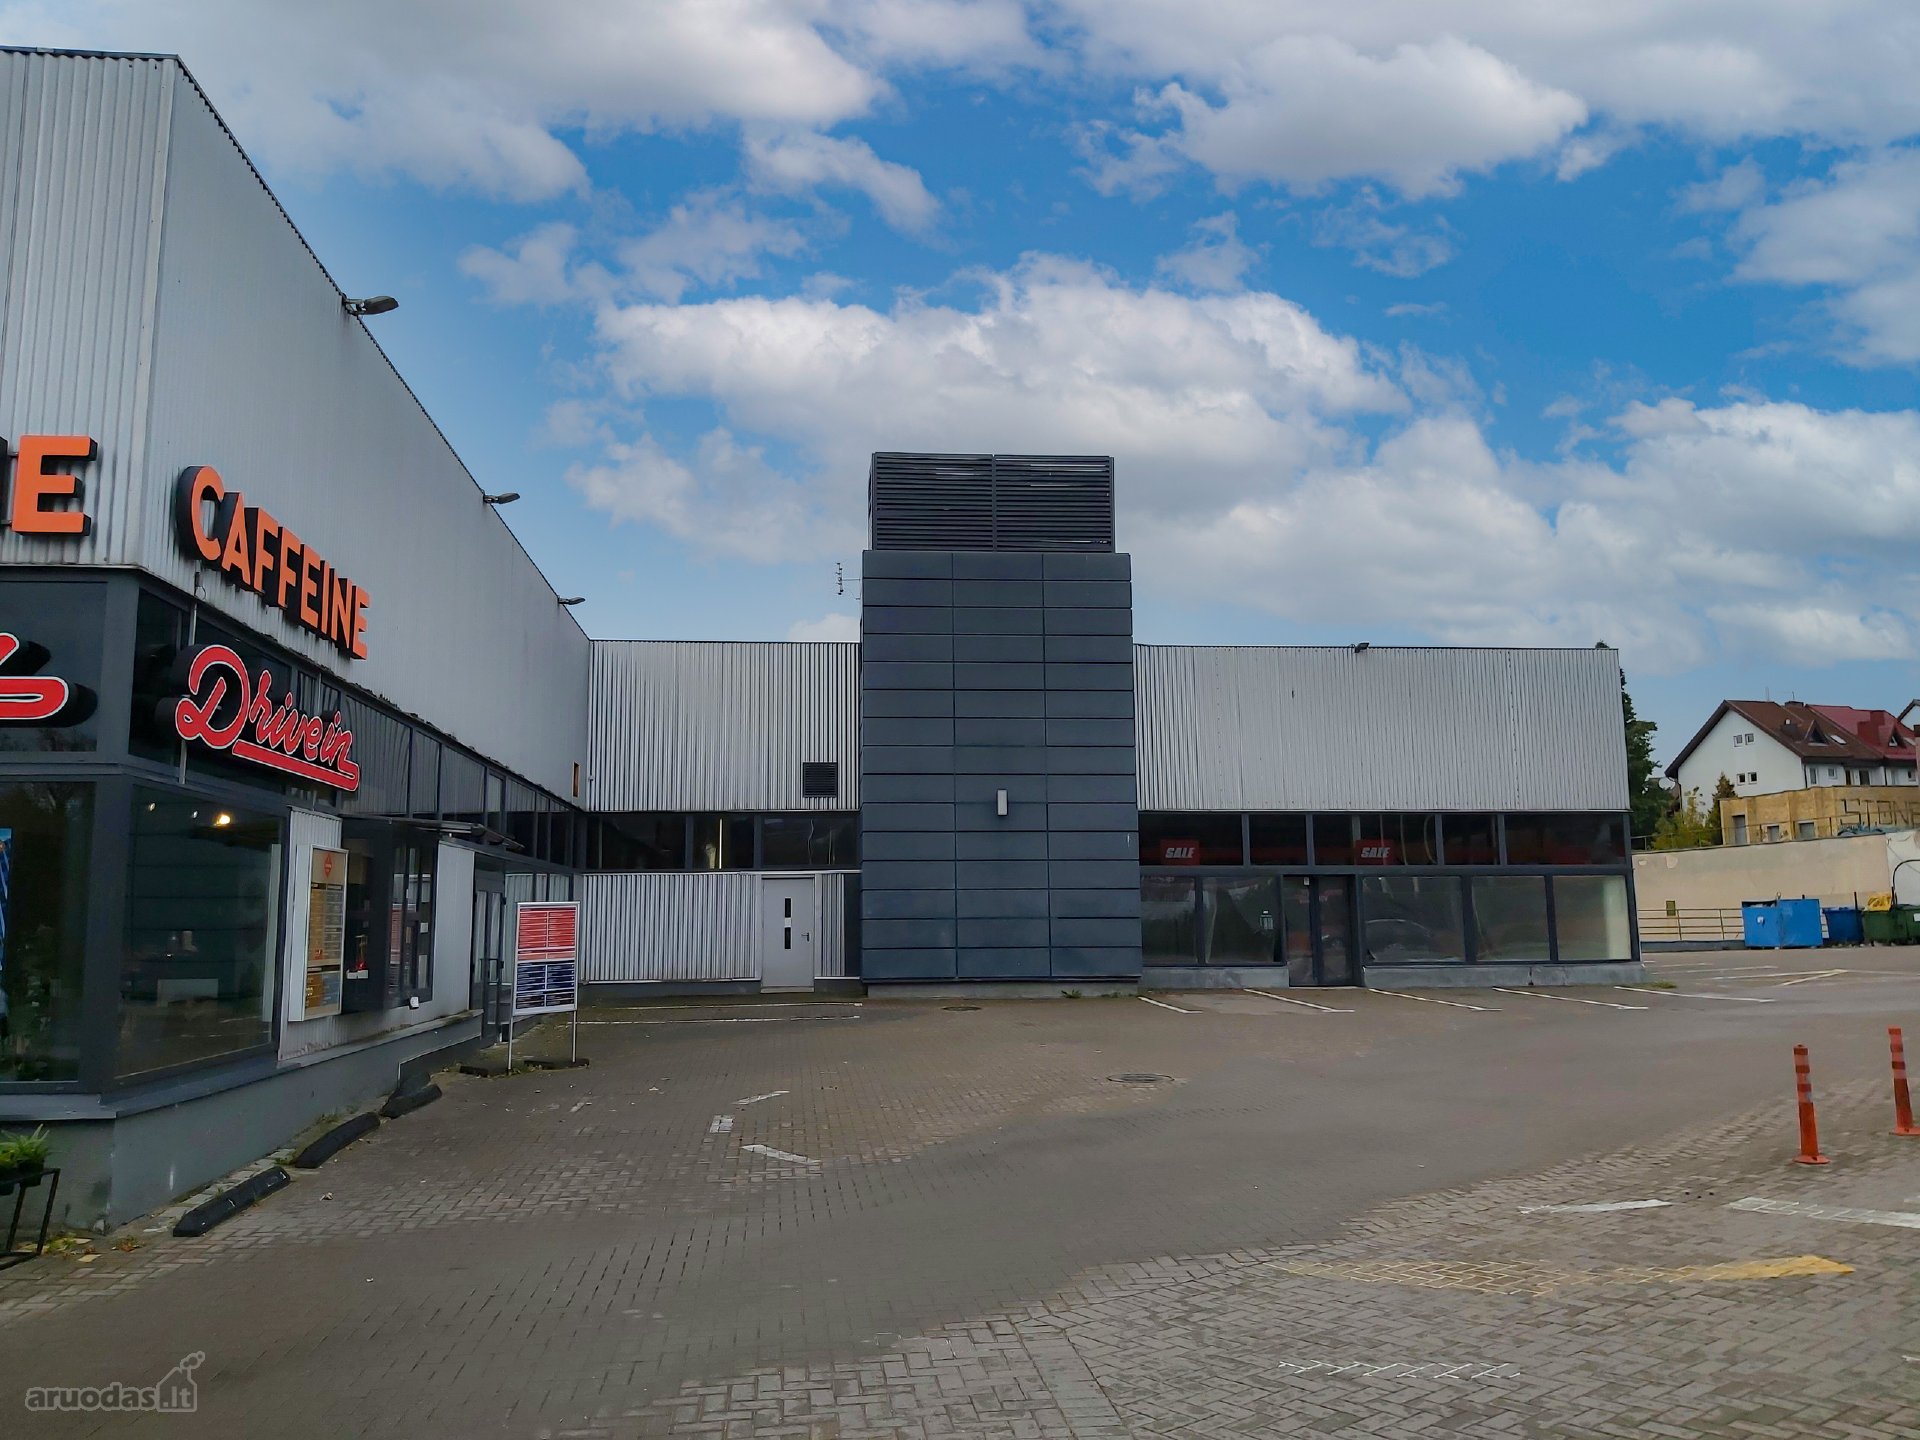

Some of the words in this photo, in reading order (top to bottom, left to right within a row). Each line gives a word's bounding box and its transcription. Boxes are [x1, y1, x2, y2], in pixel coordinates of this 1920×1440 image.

[0, 434, 98, 537] E
[177, 465, 370, 660] CAFFEINE
[1165, 847, 1196, 859] SALE
[1360, 847, 1391, 858] SALE
